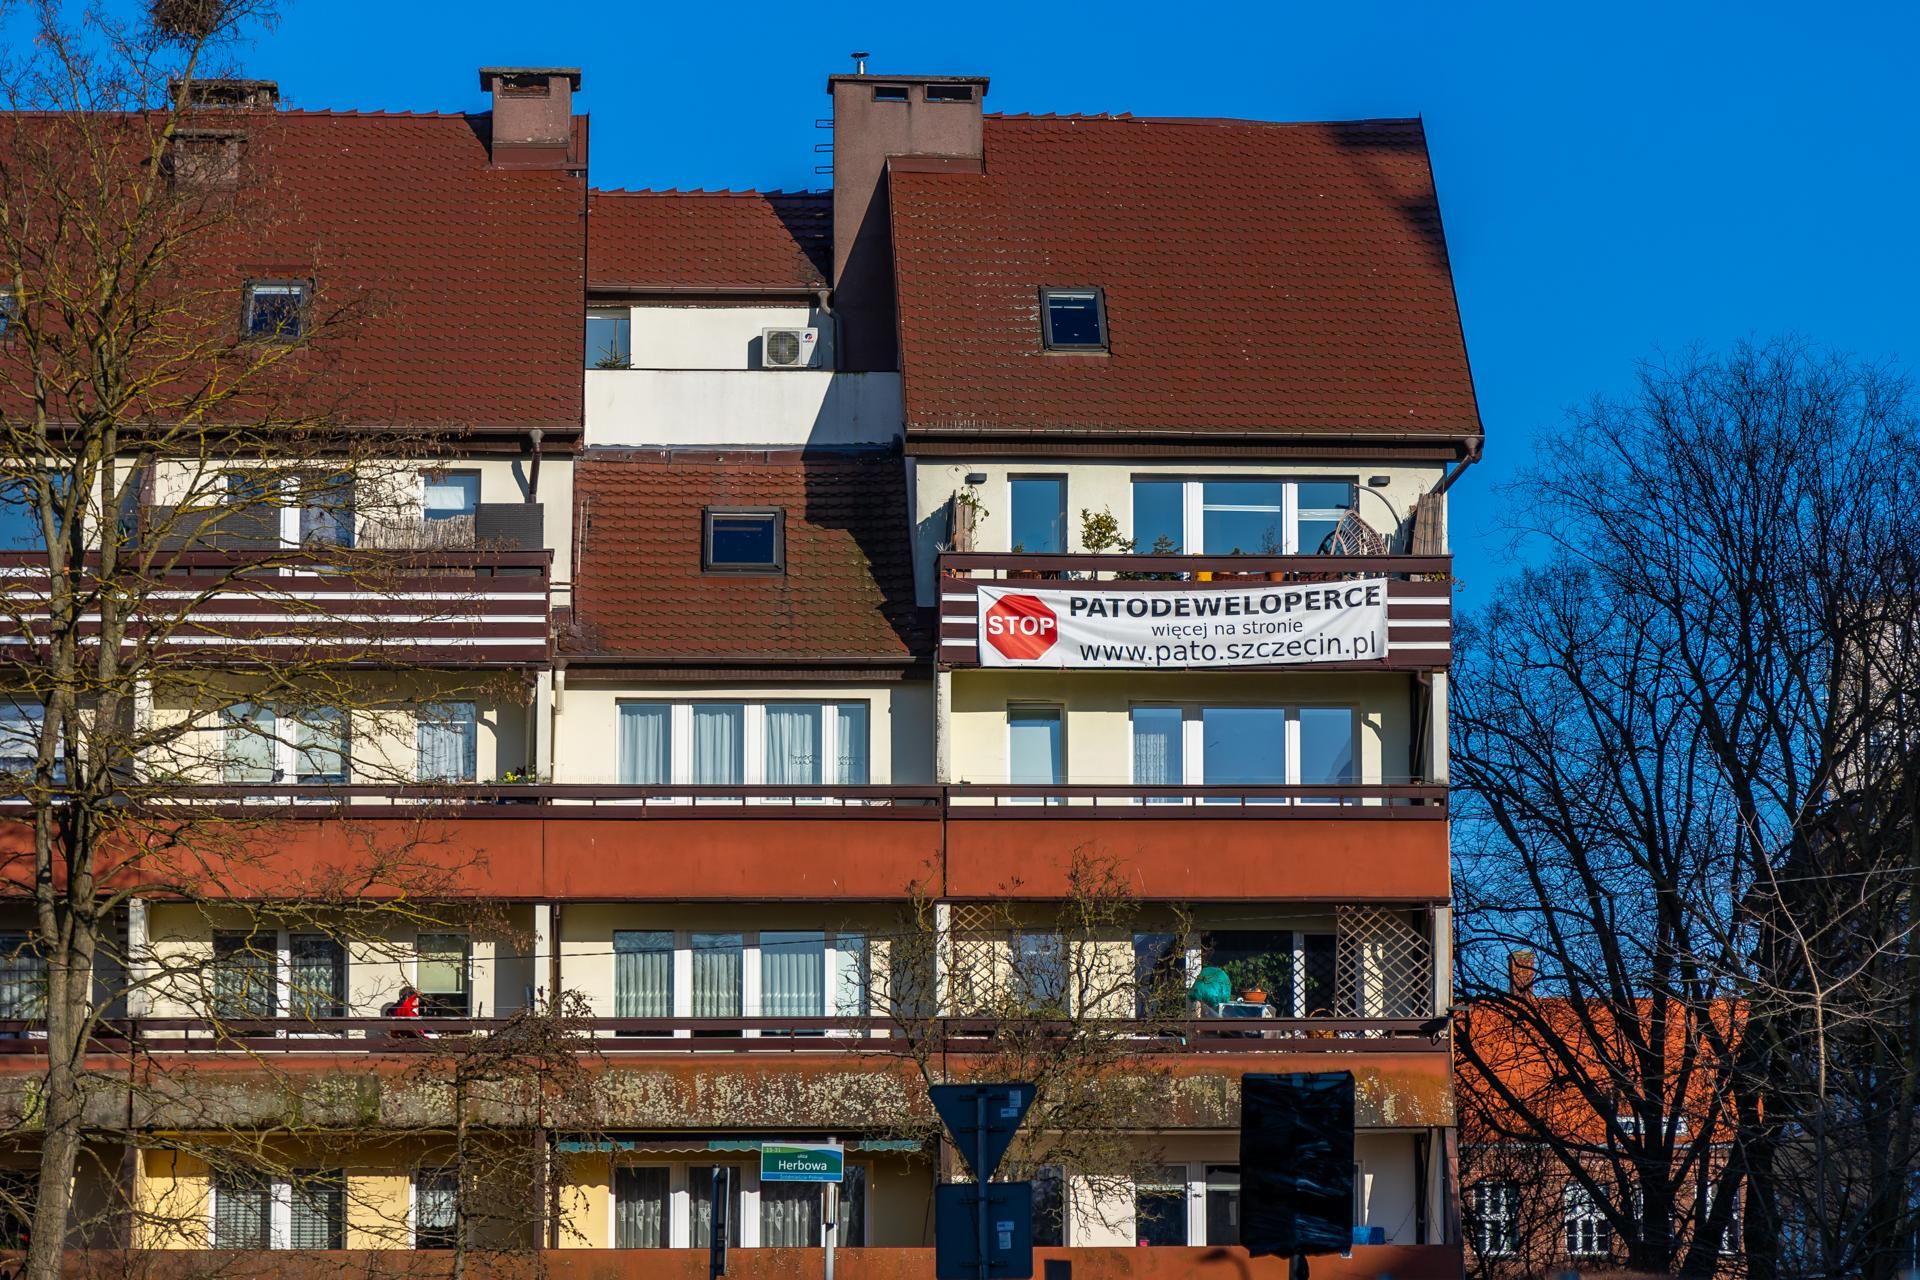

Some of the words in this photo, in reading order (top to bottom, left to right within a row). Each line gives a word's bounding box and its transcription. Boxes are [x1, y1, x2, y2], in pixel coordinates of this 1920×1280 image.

[1070, 586, 1381, 618] PATODEWELOPERCE
[988, 615, 1054, 635] STOP
[1152, 623, 1207, 639] więcej
[1215, 623, 1235, 635] na
[1243, 618, 1303, 635] stronie
[1080, 631, 1375, 666] www.pato.szczecin.pl
[778, 1160, 828, 1171] Herbowa
